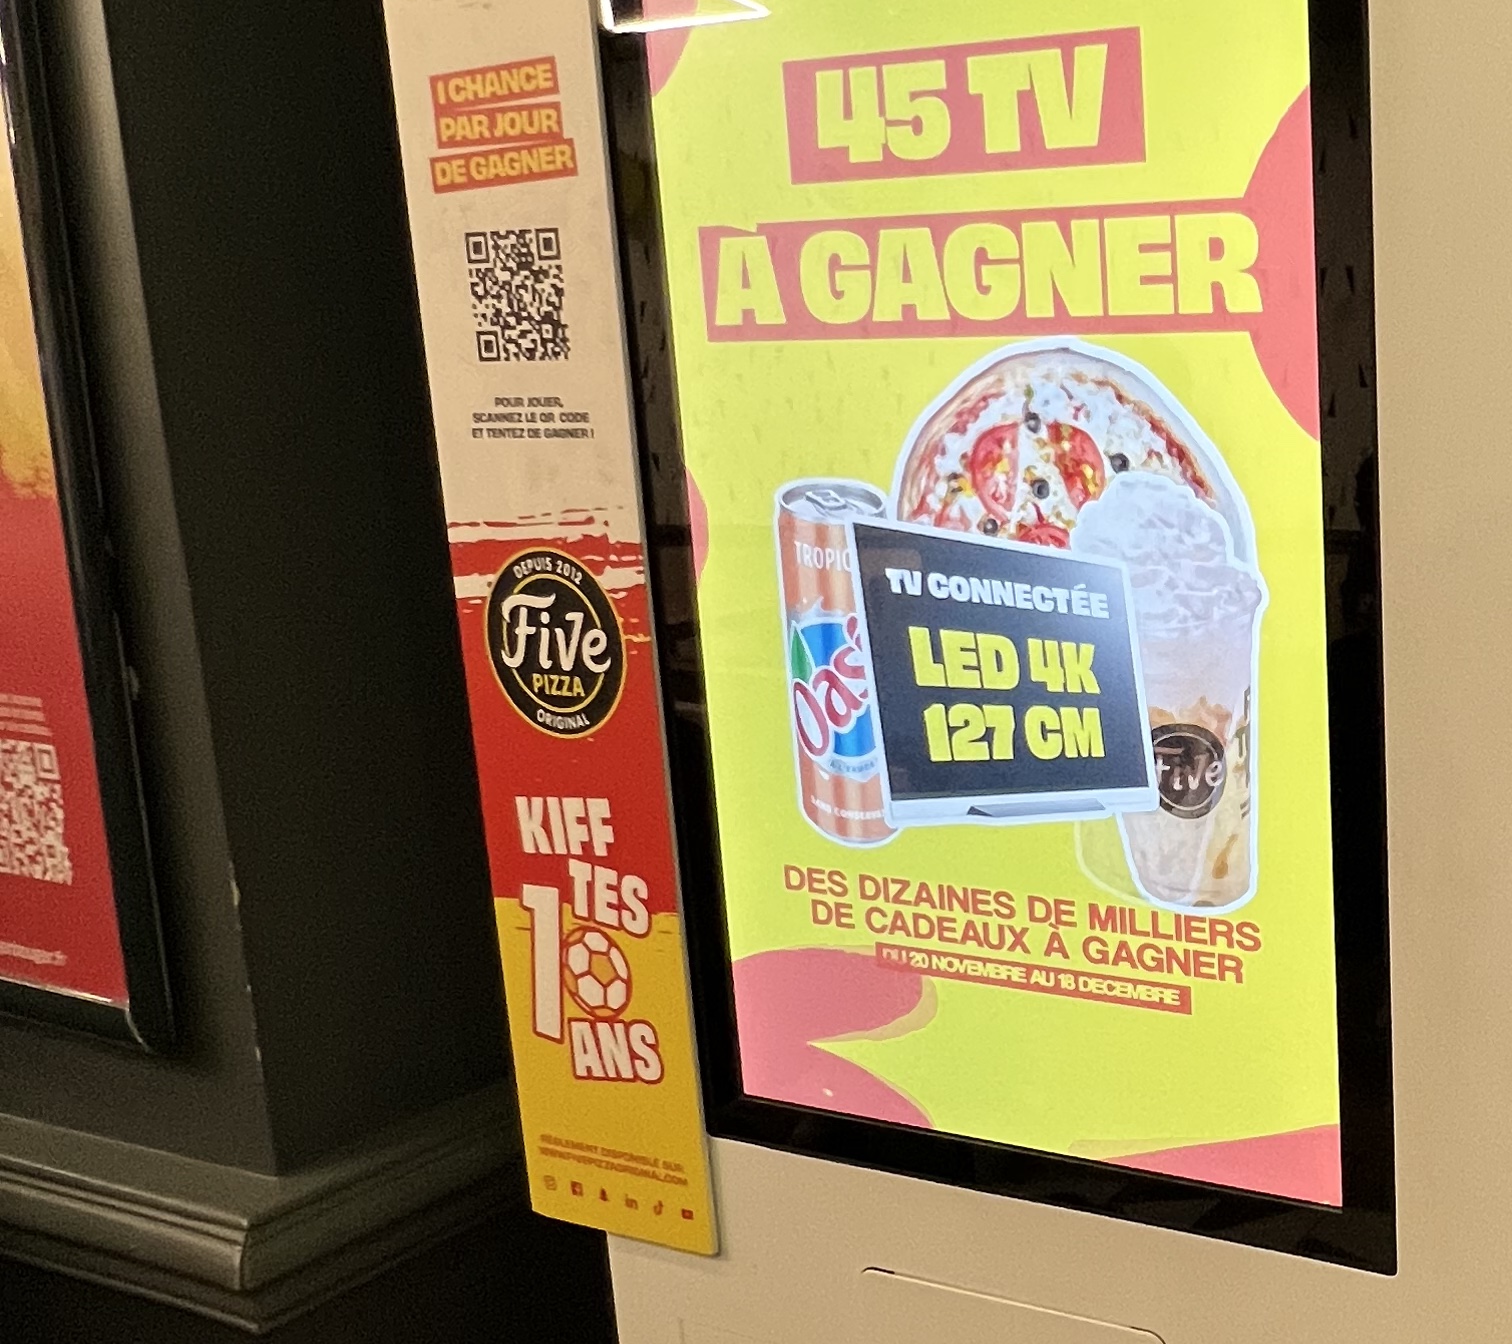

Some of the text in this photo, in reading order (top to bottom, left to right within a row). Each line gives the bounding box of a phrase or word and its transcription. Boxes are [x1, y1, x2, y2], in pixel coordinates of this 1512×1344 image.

[448, 64, 554, 103] CHANCE
[816, 43, 1109, 164] 45 TV
[439, 108, 560, 143] PAR JOUR
[434, 144, 576, 187] DE GAGNER
[800, 212, 1264, 325] GAGNER
[472, 412, 590, 424] SCANNEZ LE QR CODE
[494, 396, 525, 408] POUR
[472, 427, 485, 439] ET
[486, 427, 525, 439] TENTEZ
[527, 427, 542, 439] DE
[544, 427, 588, 439] GAGNER
[513, 557, 584, 586] DEPUIS 2012
[884, 567, 1110, 620] TV CONNECTÉE
[500, 592, 612, 674] Five
[532, 673, 586, 698] PIZZA
[908, 625, 1101, 695] LED 4K
[535, 708, 591, 730] ORIGINAL
[923, 702, 1106, 764] 127 CM
[514, 794, 616, 857] KIFF
[567, 858, 650, 937] TES
[783, 864, 1263, 953] DES DIZAINES DE MILLIERS
[810, 898, 1245, 985] DE CADEAUX À GAGNER
[931, 955, 1027, 984] NOVEMBRE
[1030, 968, 1055, 988] AU
[1058, 972, 1076, 990] 18
[571, 1020, 663, 1082] ANS
